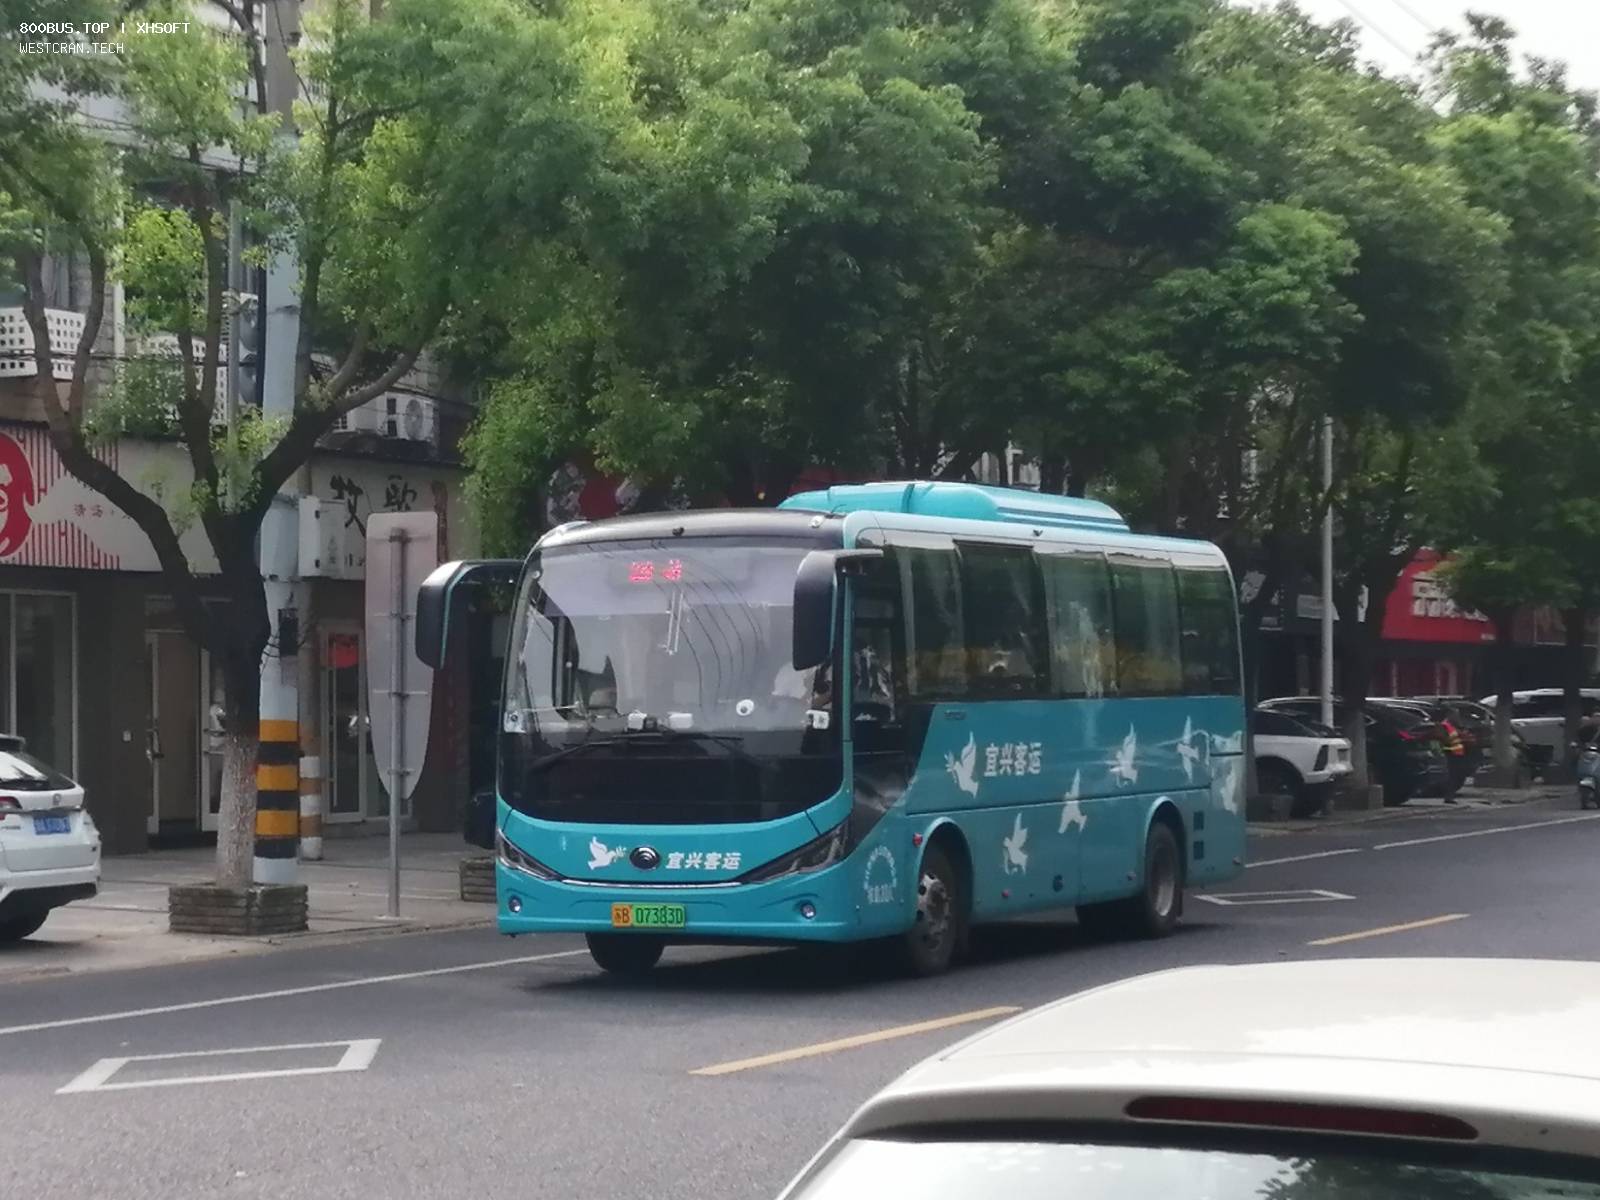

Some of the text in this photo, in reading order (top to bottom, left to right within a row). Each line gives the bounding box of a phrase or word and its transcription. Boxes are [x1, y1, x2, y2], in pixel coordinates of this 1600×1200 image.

[983, 741, 1042, 777] 宜兴客运
[665, 851, 742, 870] 宜兴客运
